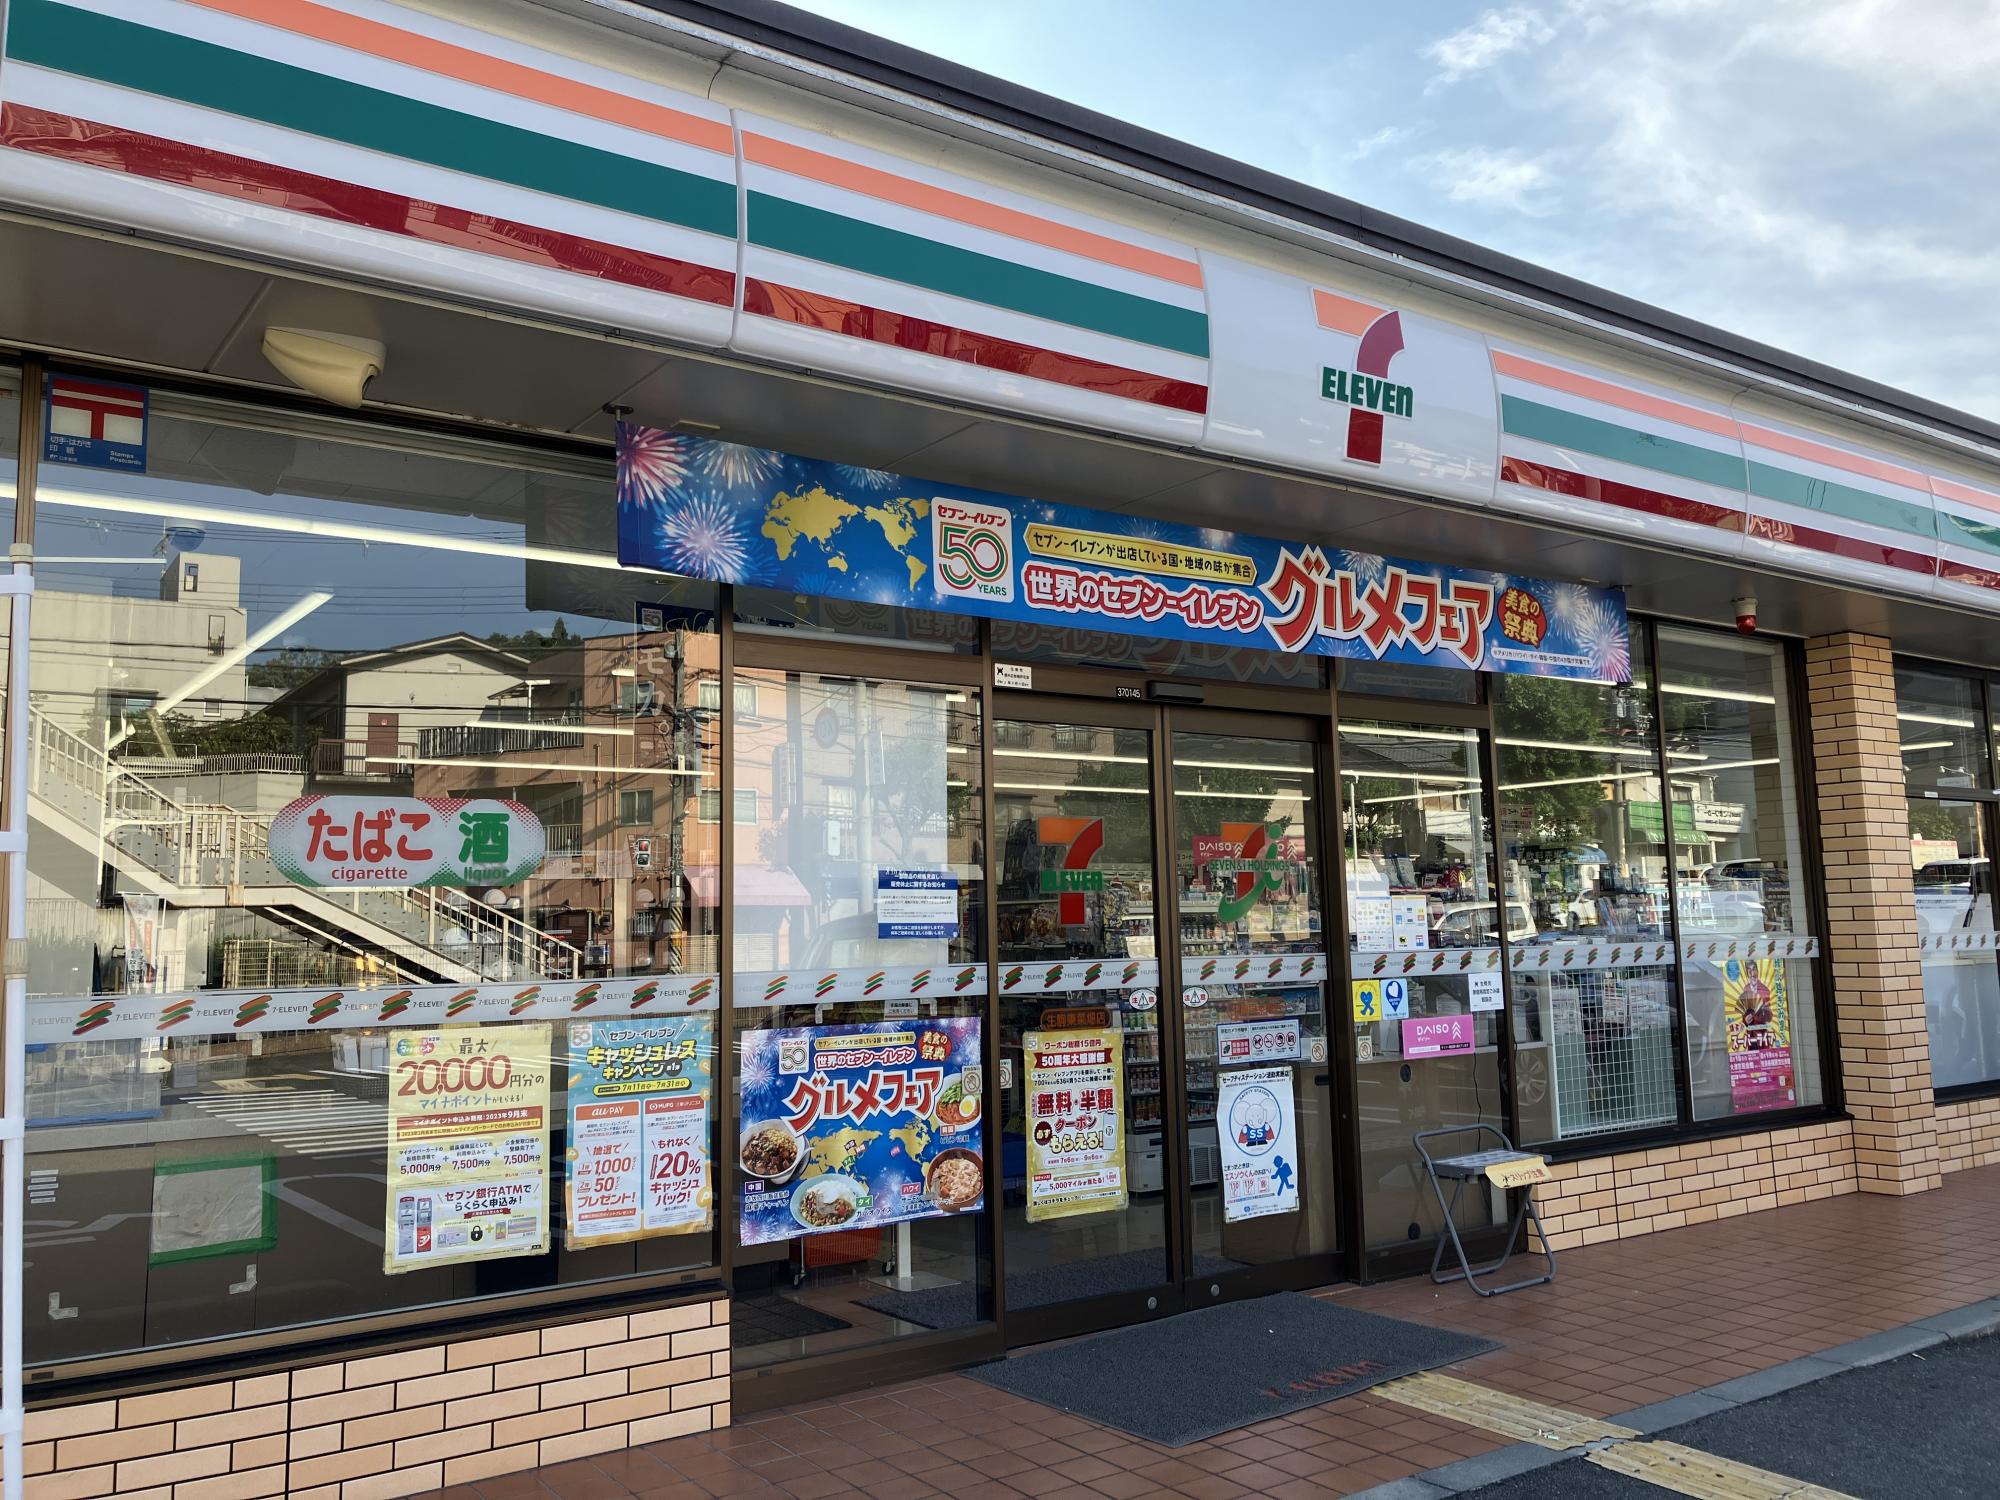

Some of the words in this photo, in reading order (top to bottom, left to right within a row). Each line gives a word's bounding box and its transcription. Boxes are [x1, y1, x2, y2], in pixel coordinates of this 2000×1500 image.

[109, 456, 142, 466] Postcards
[110, 450, 134, 459] Stamps
[938, 521, 1009, 590] 50
[976, 584, 1007, 596] YEARS
[1264, 551, 1492, 662] グルメフェア
[1505, 588, 1540, 616] 美食の
[1504, 611, 1539, 645] 祭典
[1117, 687, 1141, 698] 370145
[306, 807, 433, 863] たばこ
[458, 811, 510, 863] 酒
[1199, 842, 1232, 851] DAISO
[331, 866, 408, 882] cigarette
[923, 1031, 947, 1045] 美食の
[1416, 1024, 1449, 1036] DAISO
[459, 1037, 488, 1055] 最大
[1730, 1031, 1776, 1051] スーパーライブ
[587, 1040, 697, 1067] キャッシュレス
[921, 1044, 946, 1061] 祭典
[1041, 1052, 1105, 1066] 50周年大感謝祭
[602, 1063, 664, 1080] キャンペーン
[788, 1070, 942, 1132] グルメフェア
[1037, 1088, 1114, 1116] 無料・半額
[591, 1106, 609, 1116] au
[609, 1106, 624, 1115] PAY
[1054, 1115, 1098, 1133] クーポン
[1249, 1128, 1264, 1139] SS
[593, 1143, 622, 1156] 抽選で
[658, 1136, 691, 1149] もれなく
[1050, 1131, 1104, 1154] もらえる!
[400, 1163, 441, 1176] 5,000円分
[452, 1159, 491, 1170] 7,500円分
[503, 1153, 541, 1166] 7,500円分
[594, 1157, 631, 1176] 1,000
[657, 1151, 700, 1179] 20%
[444, 1183, 532, 1202] セブン銀行ATMで
[594, 1176, 615, 1193] 50
[650, 1178, 700, 1193] キャッシュ
[746, 1183, 763, 1192] 中国
[903, 1184, 920, 1193] ハワイ
[455, 1195, 523, 1212] らくらく申込み!
[578, 1192, 636, 1208] プレゼント!
[656, 1191, 691, 1207] バック!
[857, 1197, 872, 1206] タイ
